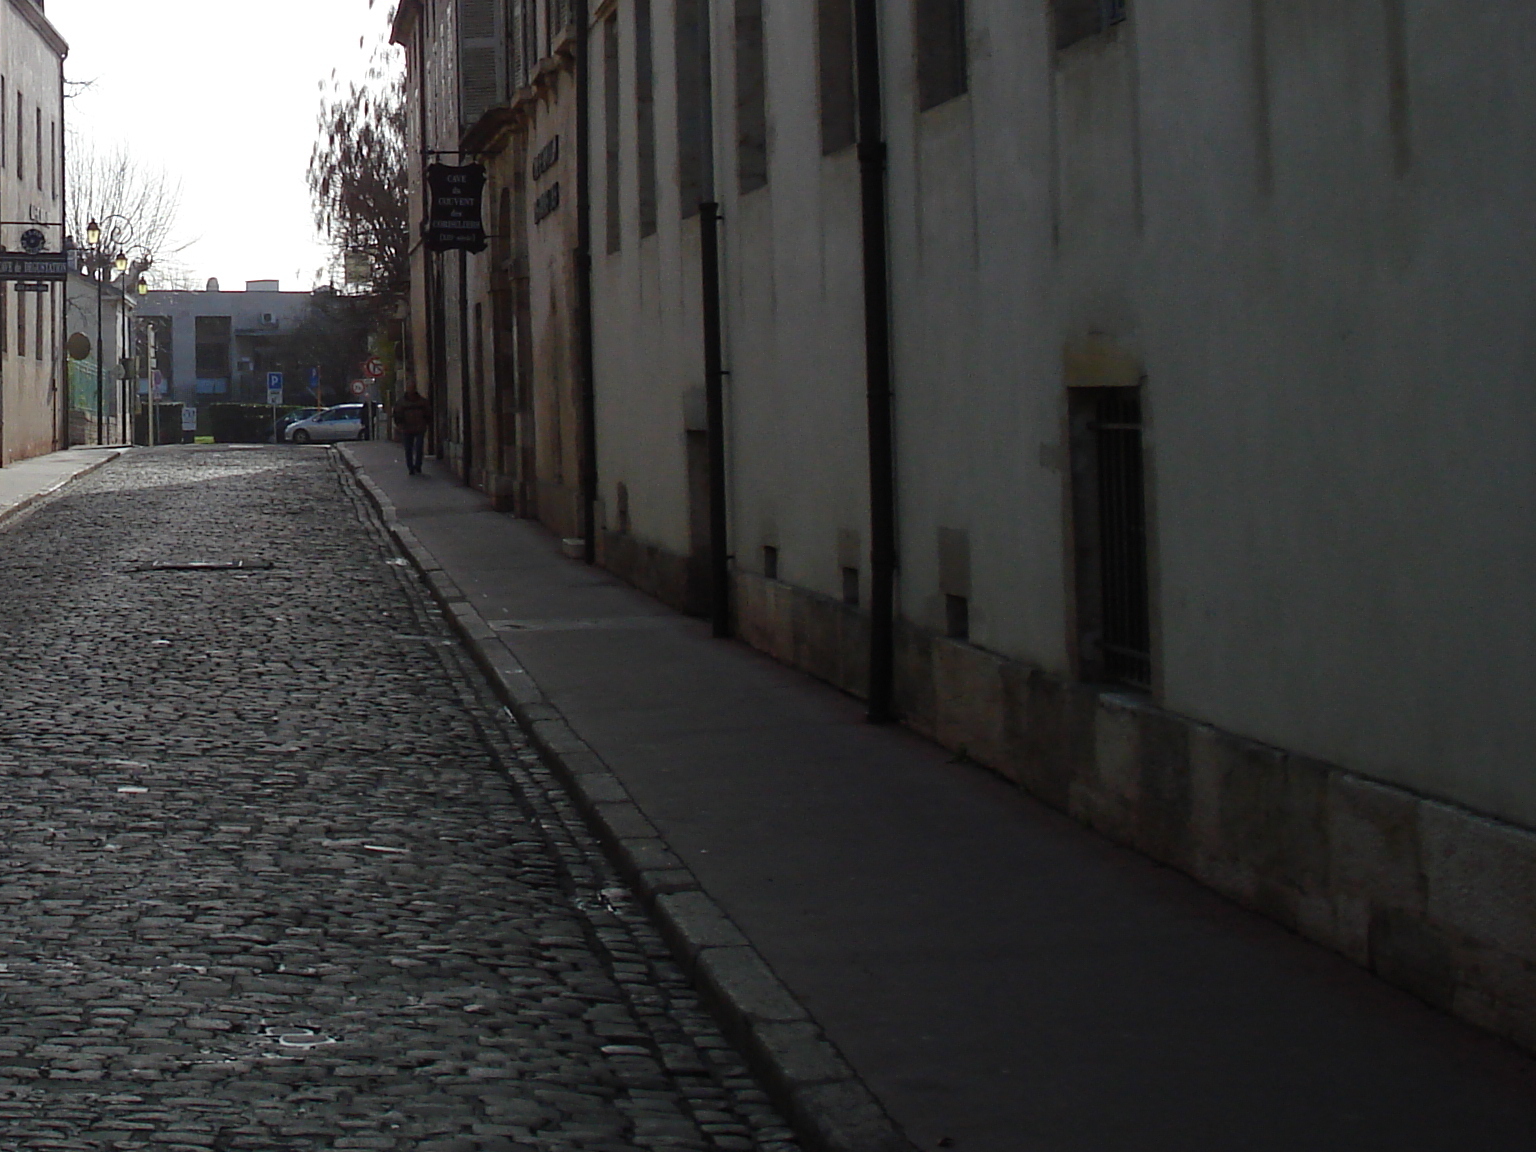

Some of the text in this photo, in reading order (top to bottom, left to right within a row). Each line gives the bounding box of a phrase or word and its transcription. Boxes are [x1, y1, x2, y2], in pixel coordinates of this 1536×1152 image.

[447, 174, 466, 183] CAVE
[438, 197, 475, 206] COUVENT
[271, 375, 279, 386] P
